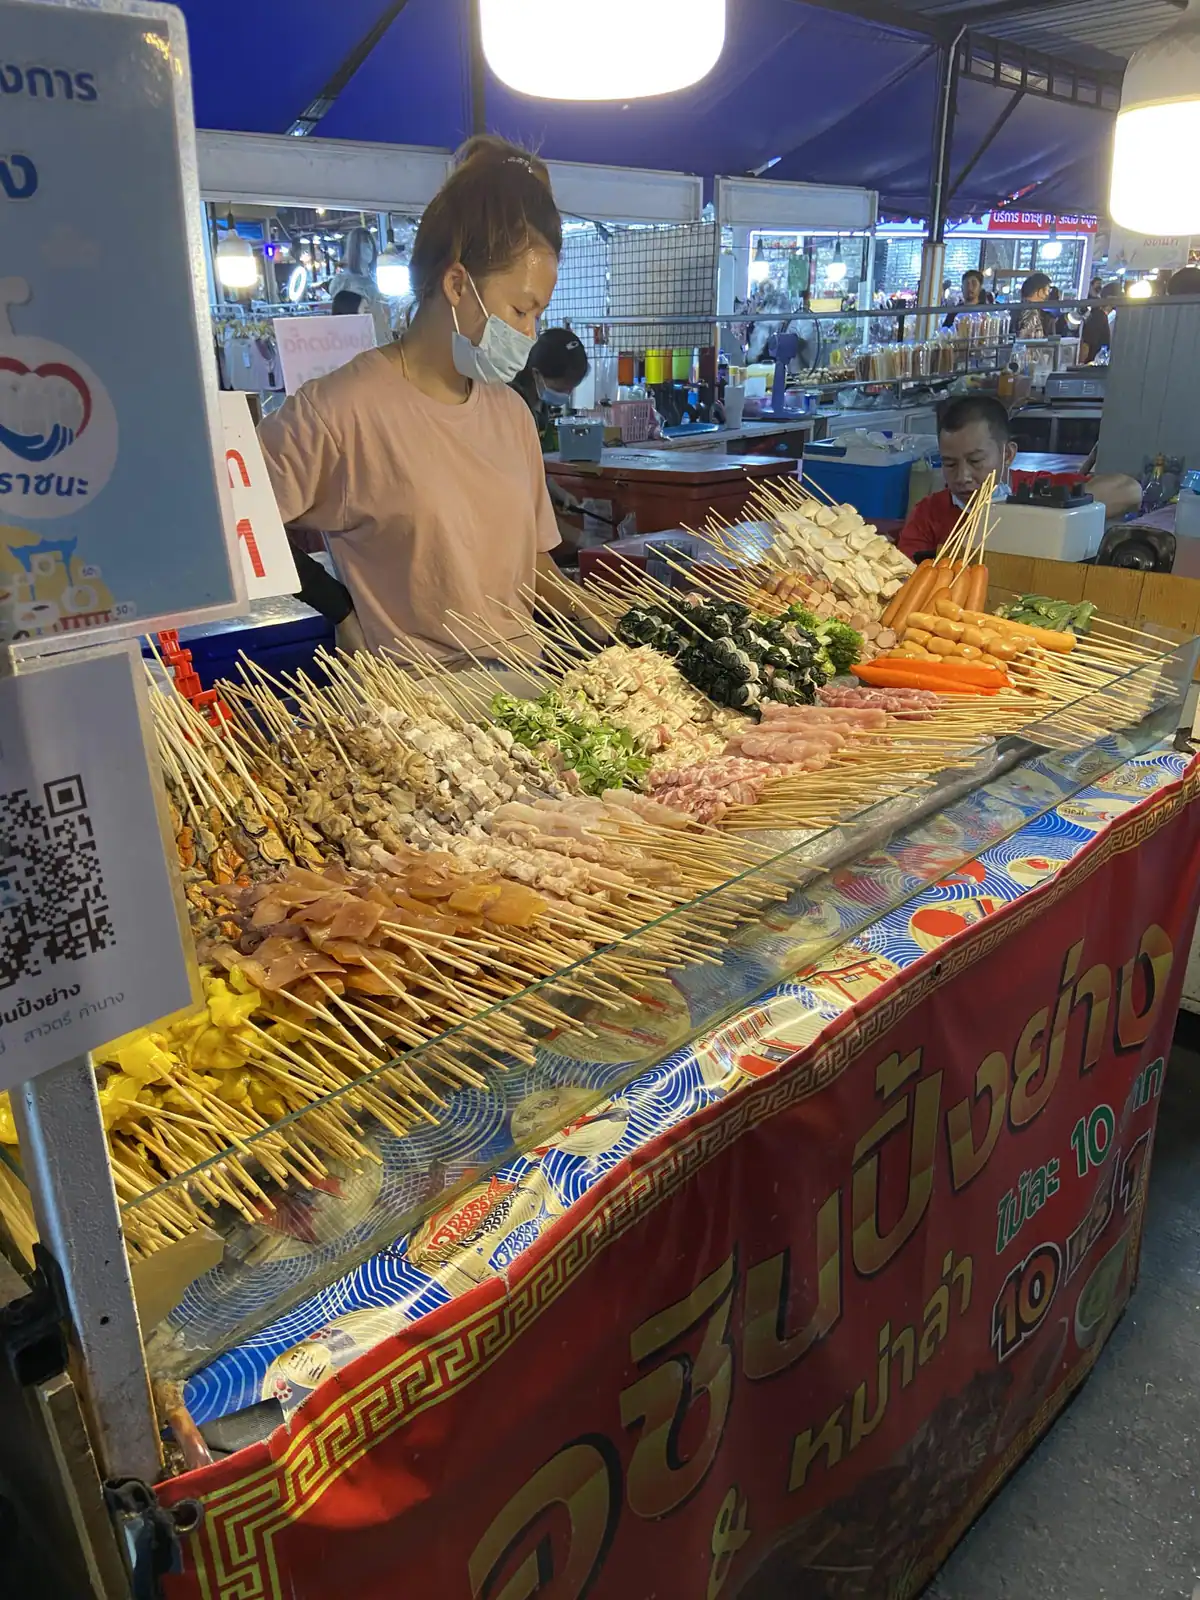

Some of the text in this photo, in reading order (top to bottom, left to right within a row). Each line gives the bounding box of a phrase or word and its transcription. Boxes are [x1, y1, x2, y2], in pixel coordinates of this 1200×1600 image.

[993, 210, 1019, 223] บริการ
[0, 984, 81, 1026] นปิ้งย่าง
[1071, 1103, 1116, 1178] 10
[1130, 1056, 1165, 1113] าท
[993, 1244, 1062, 1360] 10
